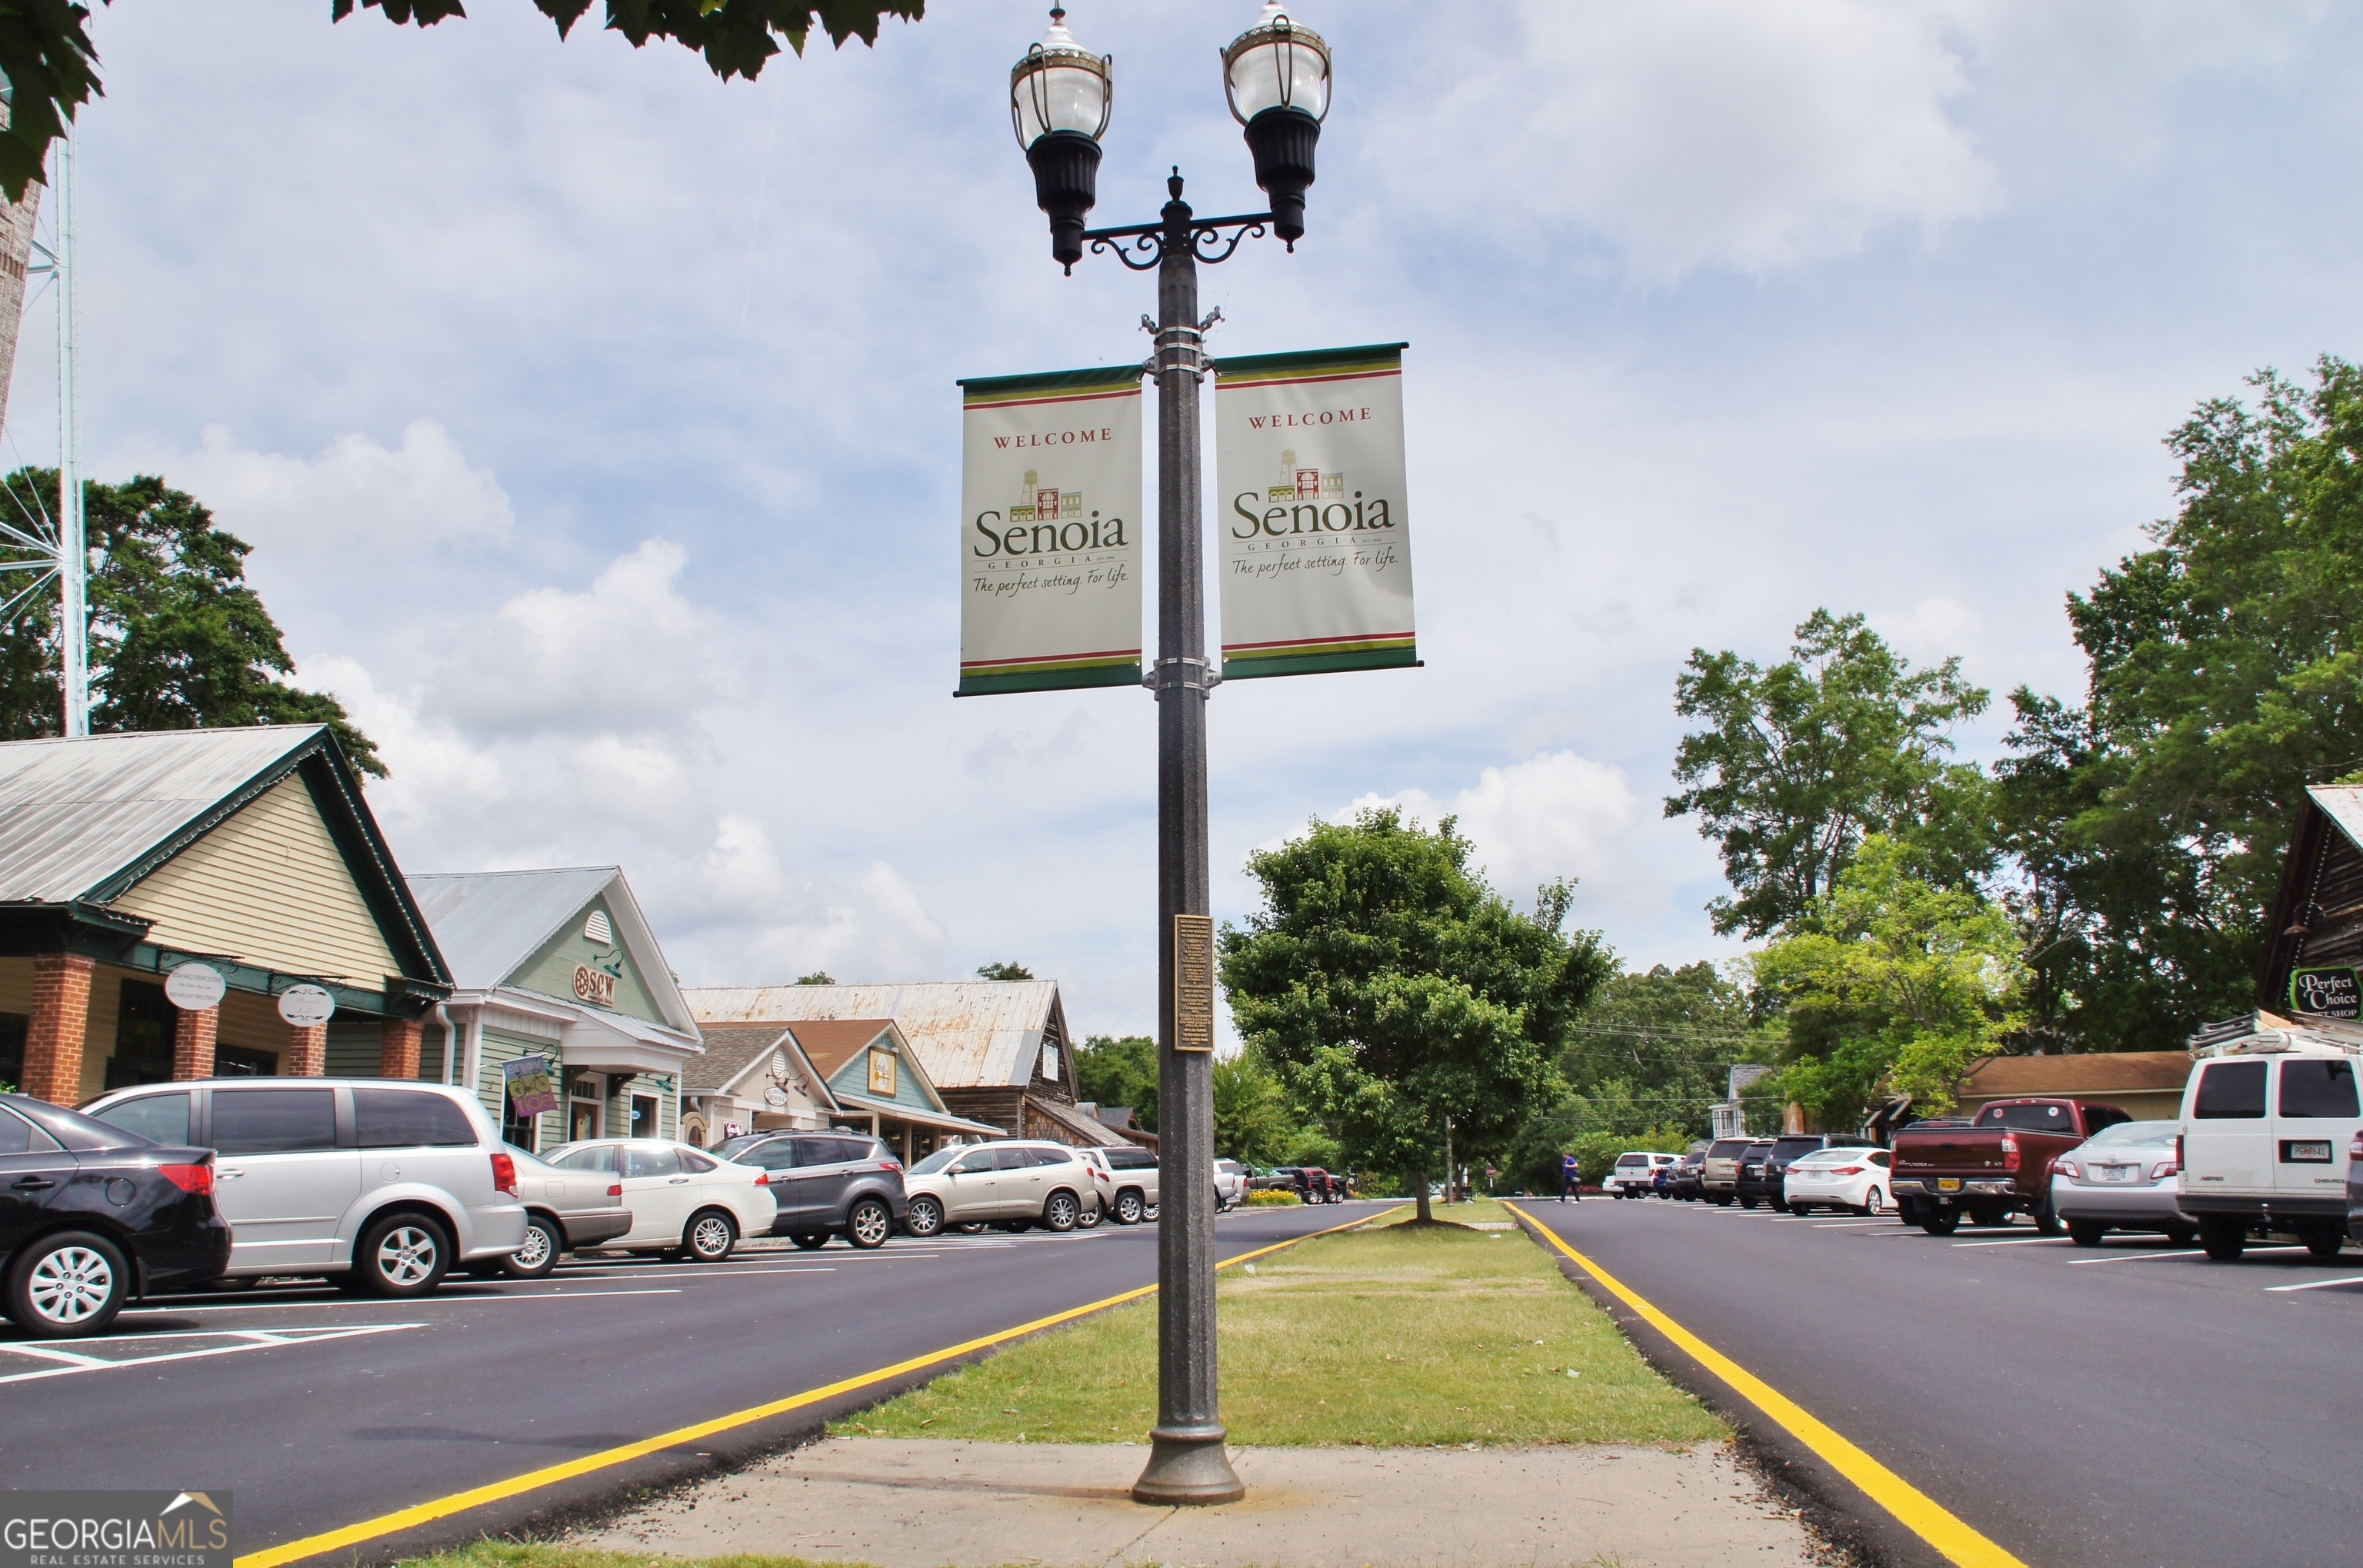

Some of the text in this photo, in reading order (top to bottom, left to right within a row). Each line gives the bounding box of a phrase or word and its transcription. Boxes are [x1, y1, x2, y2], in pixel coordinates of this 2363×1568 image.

[1248, 408, 1372, 429] WELCOME
[994, 428, 1112, 449] WELCOME
[1231, 491, 1395, 539] Senoia
[974, 510, 1128, 558] Senoia
[1232, 546, 1398, 578] The perfect setting. For life.
[973, 564, 1129, 598] The perfect setting. For life.
[589, 971, 615, 997] SCW
[2298, 974, 2352, 994] Perfect
[2303, 990, 2357, 1010] Choice
[2331, 1009, 2357, 1017] SHOP
[518, 1094, 555, 1114] ride
[769, 1094, 785, 1103] SENOIA
